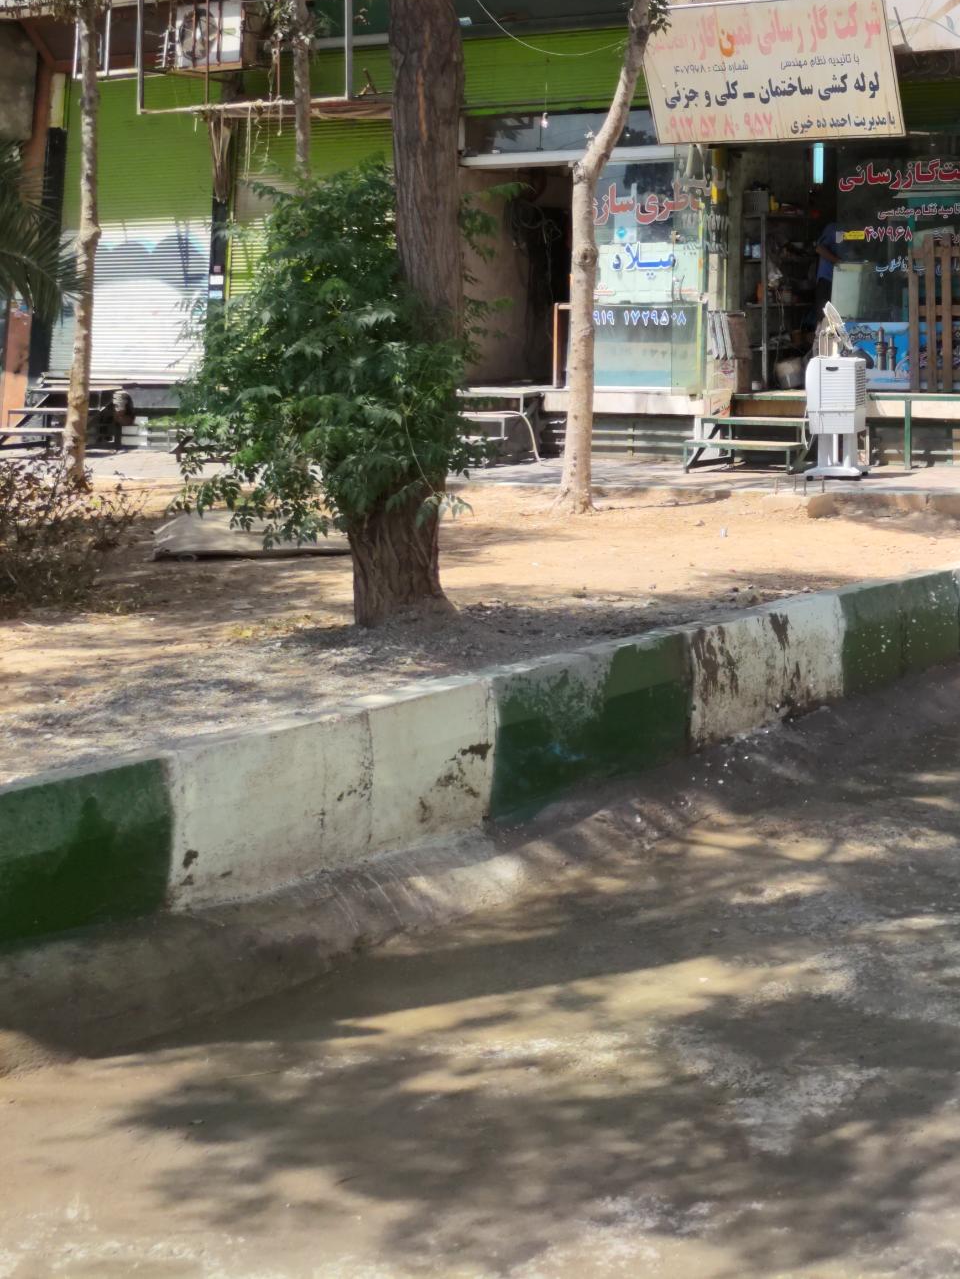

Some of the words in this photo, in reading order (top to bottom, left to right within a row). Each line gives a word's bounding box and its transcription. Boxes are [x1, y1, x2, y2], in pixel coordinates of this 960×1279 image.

[807, 4, 829, 53] گاز
[714, 80, 738, 107] کلی
[758, 76, 814, 104] ساختمان
[818, 74, 848, 101] کشی
[854, 71, 880, 98] لوله
[853, 115, 887, 131] مدیریت
[838, 162, 902, 192] رسانی
[612, 241, 676, 279] میلاد
